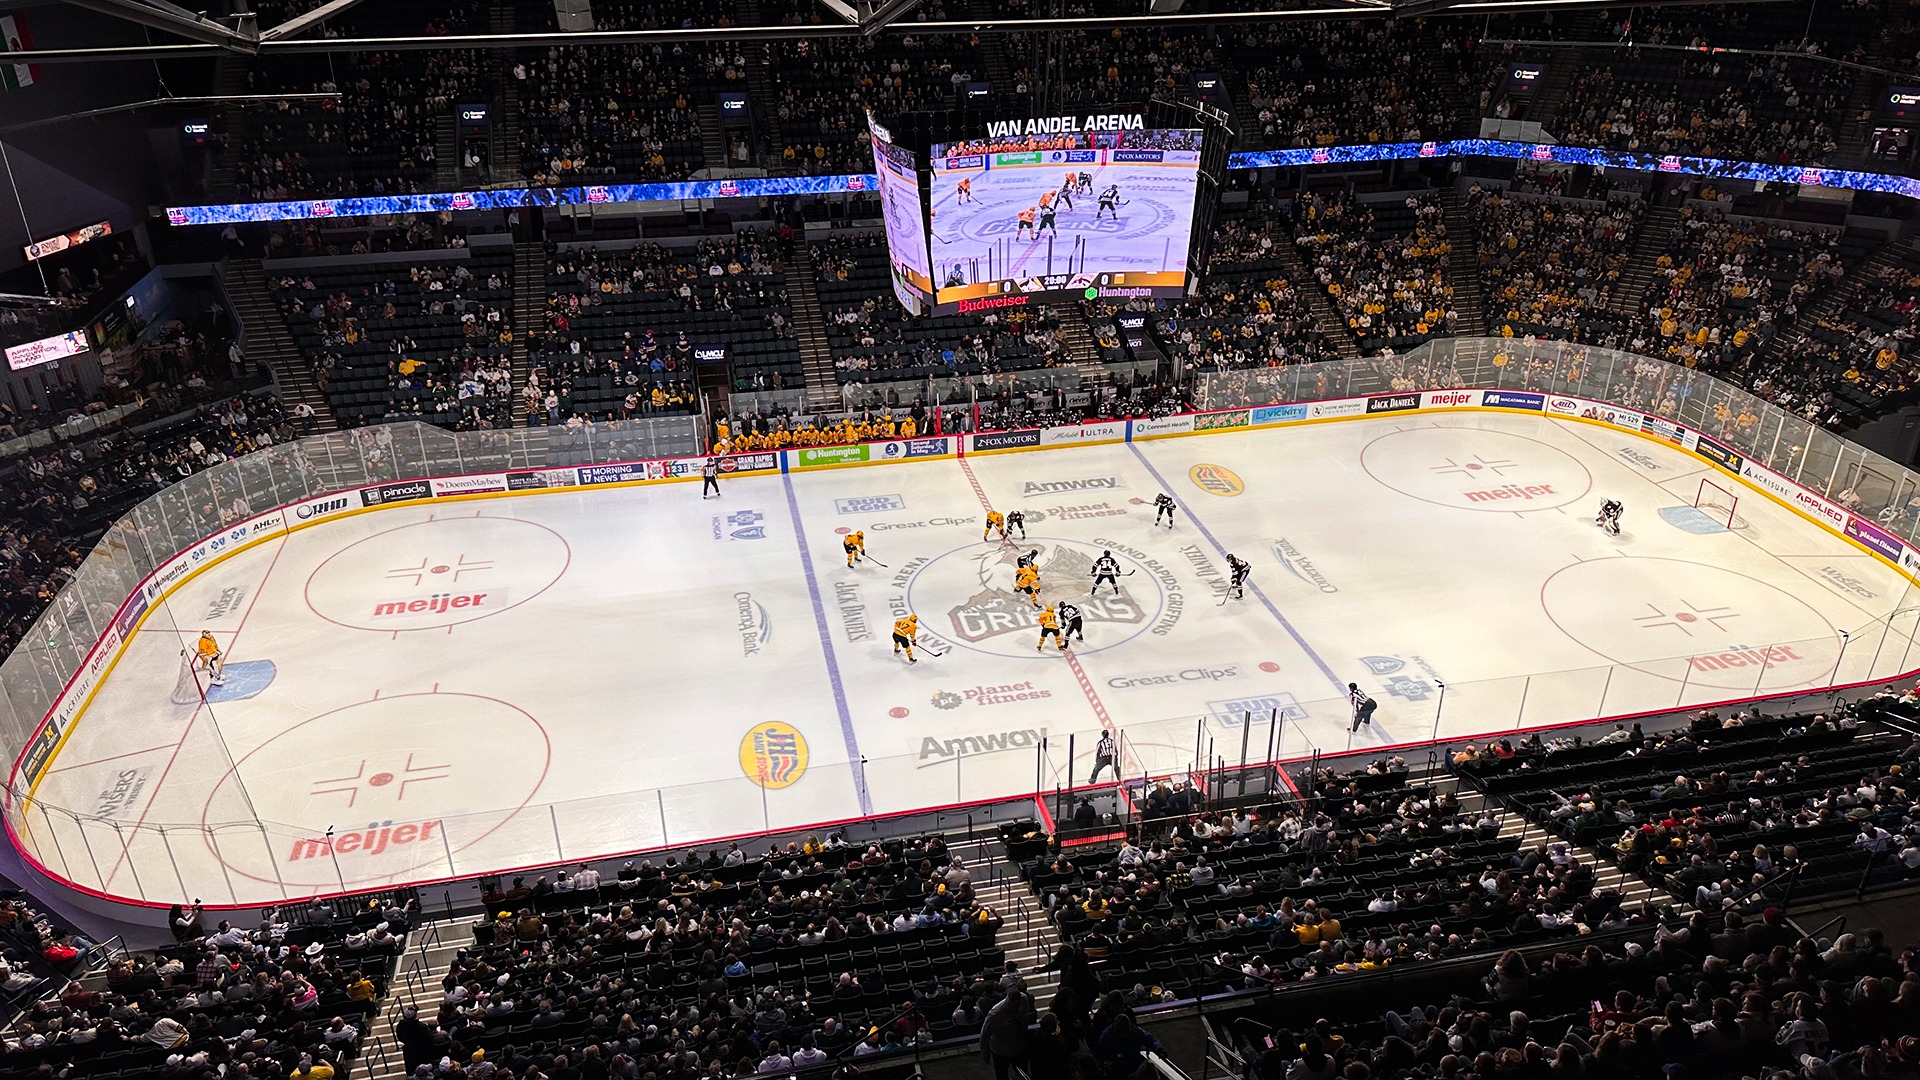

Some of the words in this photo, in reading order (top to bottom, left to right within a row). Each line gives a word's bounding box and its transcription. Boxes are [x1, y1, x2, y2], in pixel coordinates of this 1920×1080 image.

[987, 120, 1022, 138] VAN
[1025, 117, 1081, 134] ANDEL
[1083, 114, 1144, 131] ARENA
[1004, 281, 1011, 293] 0
[1044, 275, 1067, 285] 20:00
[1101, 275, 1109, 285] 0
[1098, 286, 1152, 298] Huntington
[957, 295, 1028, 313] Budweiser
[1371, 399, 1389, 410] JACK
[1390, 396, 1416, 409] DANIEL'S
[1431, 392, 1472, 406] meijer
[986, 436, 1003, 446] FOX
[1003, 434, 1037, 445] MOTORS
[1086, 428, 1114, 437] ULTRA
[817, 448, 861, 458] Huntington
[583, 474, 592, 483] 17
[593, 466, 632, 475] MORNING
[594, 474, 618, 483] NEWS
[383, 483, 426, 499] pinnacle
[446, 478, 501, 489] DoerenMayhew
[1024, 477, 1117, 494] Amway
[1464, 483, 1557, 502] meijer
[1754, 473, 1789, 496] ACRISURE
[842, 502, 900, 513] LIGHT
[848, 497, 890, 506] BUD
[1047, 502, 1111, 517] planet
[1796, 493, 1843, 522] APPLIED
[1059, 507, 1127, 520] fitness
[1794, 499, 1841, 527] INNOVATION
[871, 521, 926, 531] Great
[1093, 538, 1146, 562] GRAND
[1859, 531, 1880, 545] planet
[1879, 540, 1900, 557] fitness
[891, 557, 929, 588] ARENA
[1145, 559, 1180, 591] RAPIDS
[834, 581, 860, 607] JACK
[373, 593, 488, 617] meijer
[1152, 591, 1184, 636] GRIFFINS
[840, 604, 869, 643] DANIEL'S
[742, 632, 761, 658] Bank
[916, 633, 953, 655] VAN
[90, 633, 117, 674] APPLIED
[1686, 645, 1804, 673] meijer
[962, 681, 1034, 700] planet
[1108, 674, 1178, 689] Great
[65, 679, 90, 716] ACRISURE
[978, 688, 1052, 706] fitness
[1224, 698, 1281, 714] BUD
[919, 728, 1048, 760] Amway
[289, 818, 442, 862] meijer
